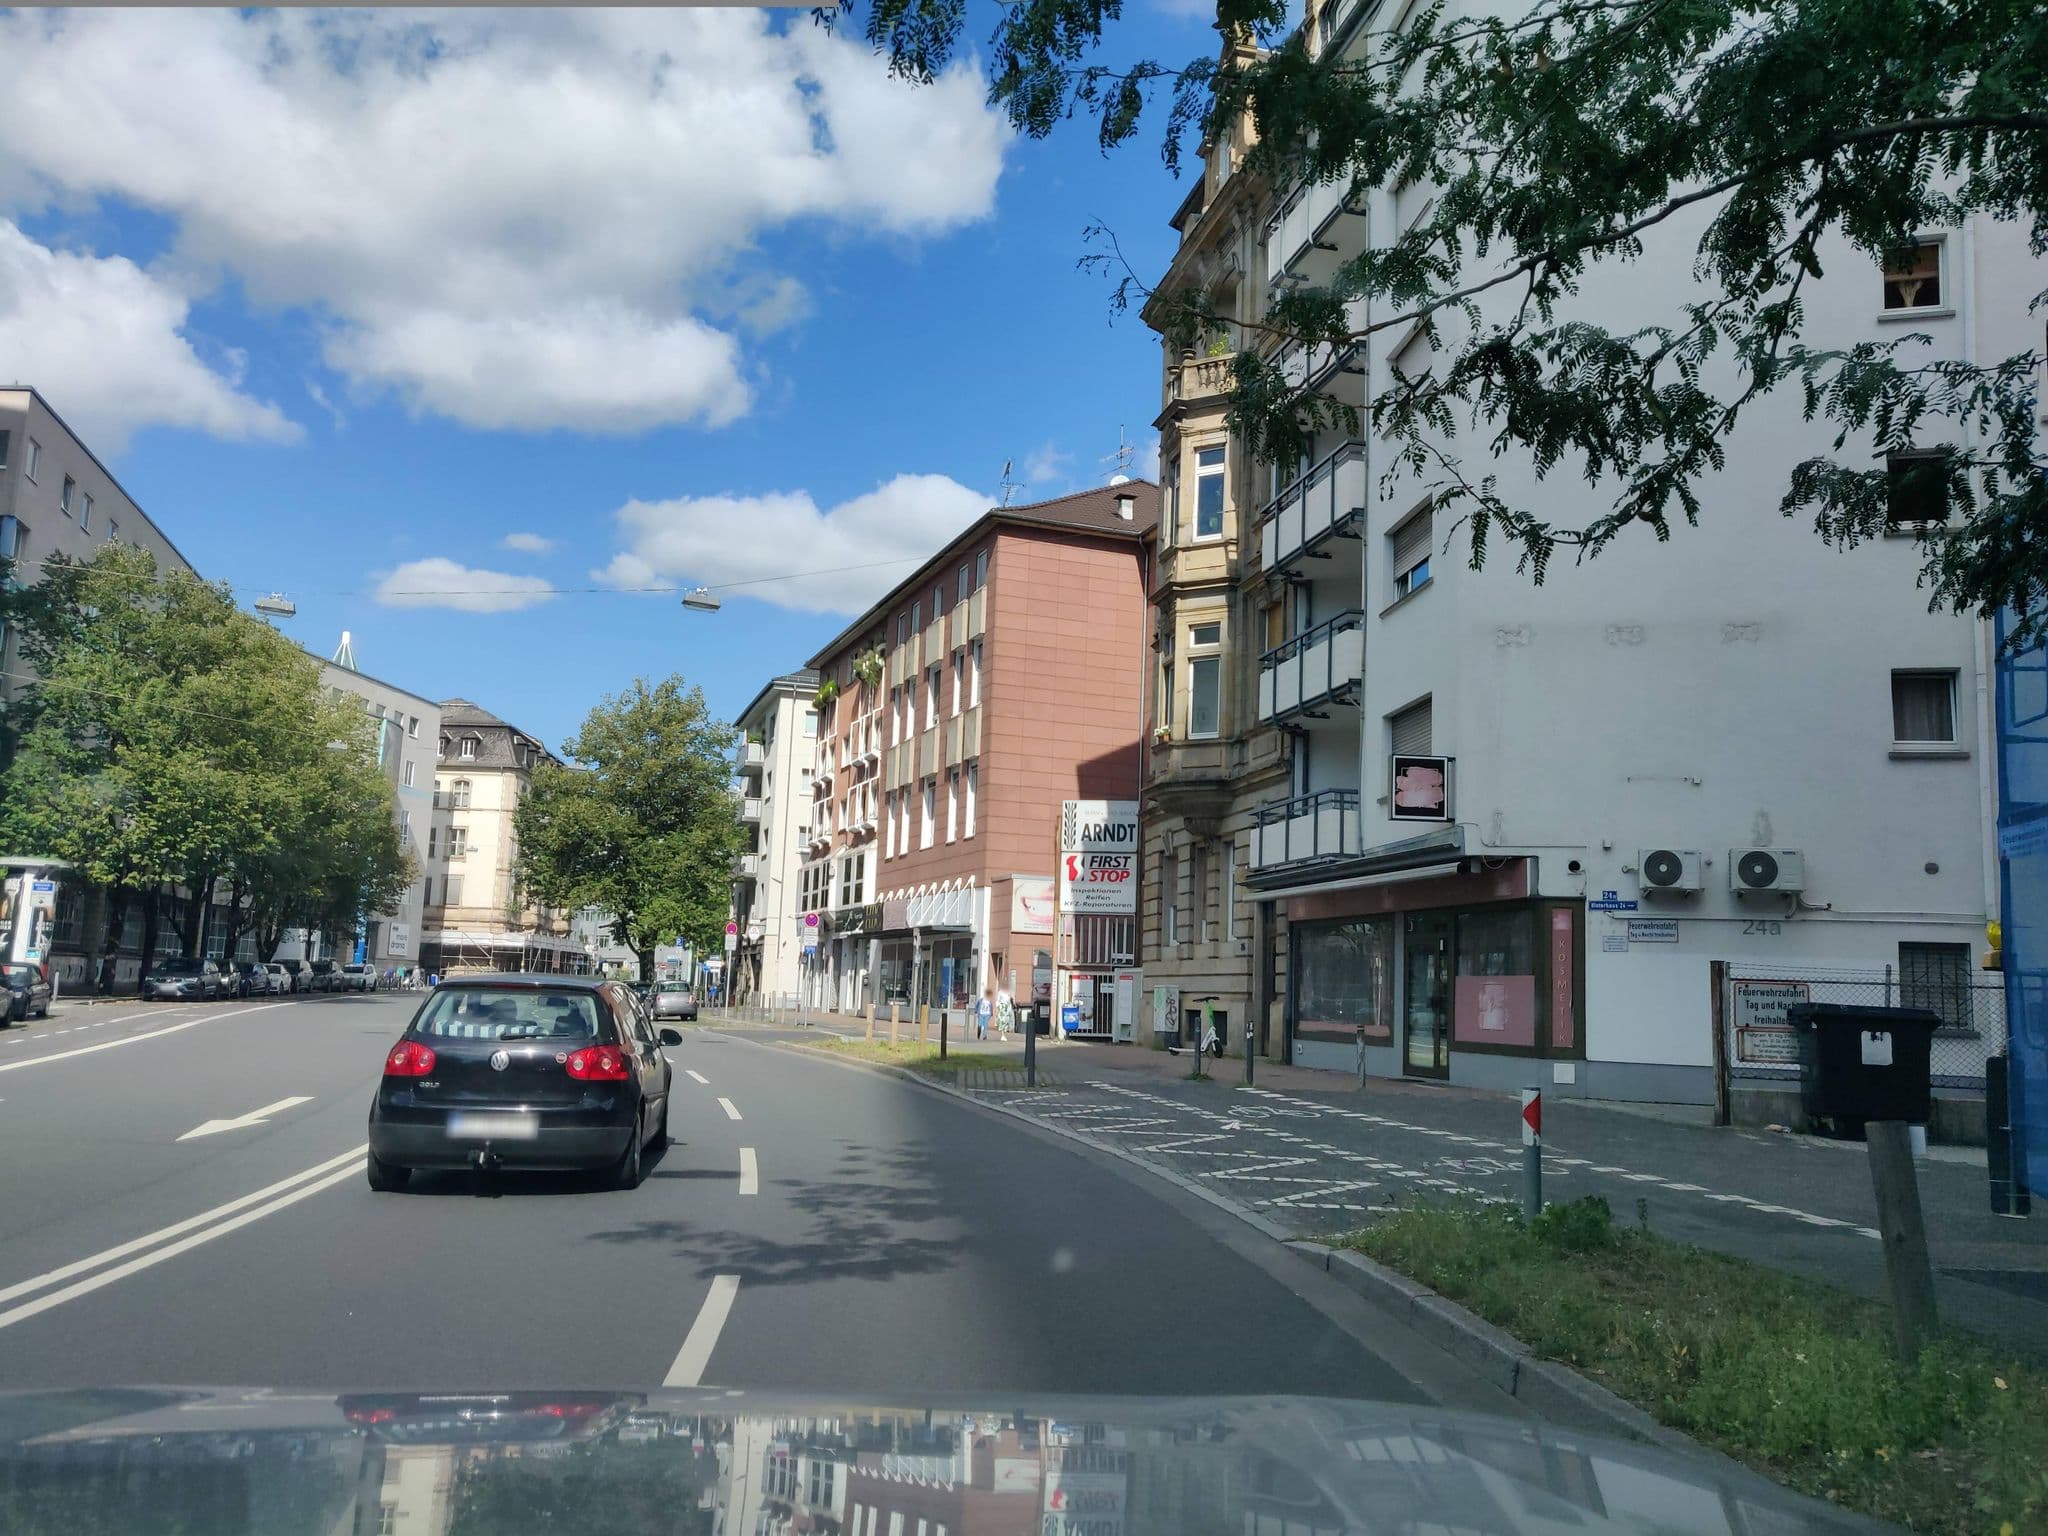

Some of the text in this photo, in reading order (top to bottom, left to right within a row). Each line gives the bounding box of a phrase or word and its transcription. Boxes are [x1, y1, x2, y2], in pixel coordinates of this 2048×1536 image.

[1081, 823, 1136, 842] ARNDT
[1089, 855, 1131, 867] FIRST
[1089, 870, 1130, 882] STOP
[1742, 919, 1781, 936] 24a
[1558, 939, 1567, 1041] KOSMETIK
[1738, 986, 1806, 998] Feuerwehrzufahrt
[1746, 1000, 1759, 1011] Tag
[1761, 1000, 1775, 1010] und
